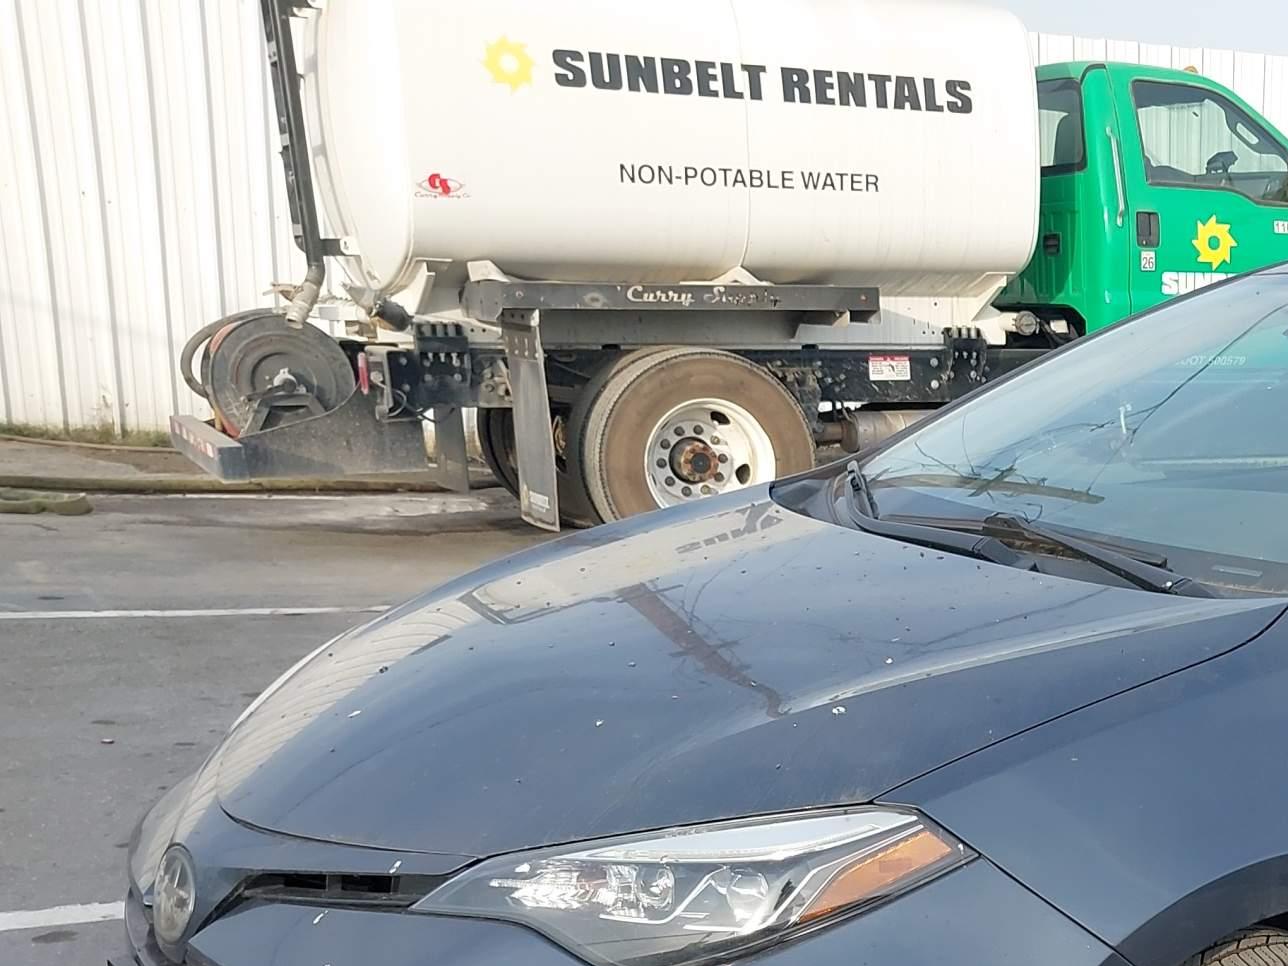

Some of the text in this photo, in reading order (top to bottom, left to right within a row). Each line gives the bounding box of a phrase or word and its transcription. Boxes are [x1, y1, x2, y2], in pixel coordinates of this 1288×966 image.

[552, 48, 973, 114] SUNBELT RENTALS
[619, 163, 880, 193] NON-POTABLE WATER
[1142, 256, 1154, 269] 26
